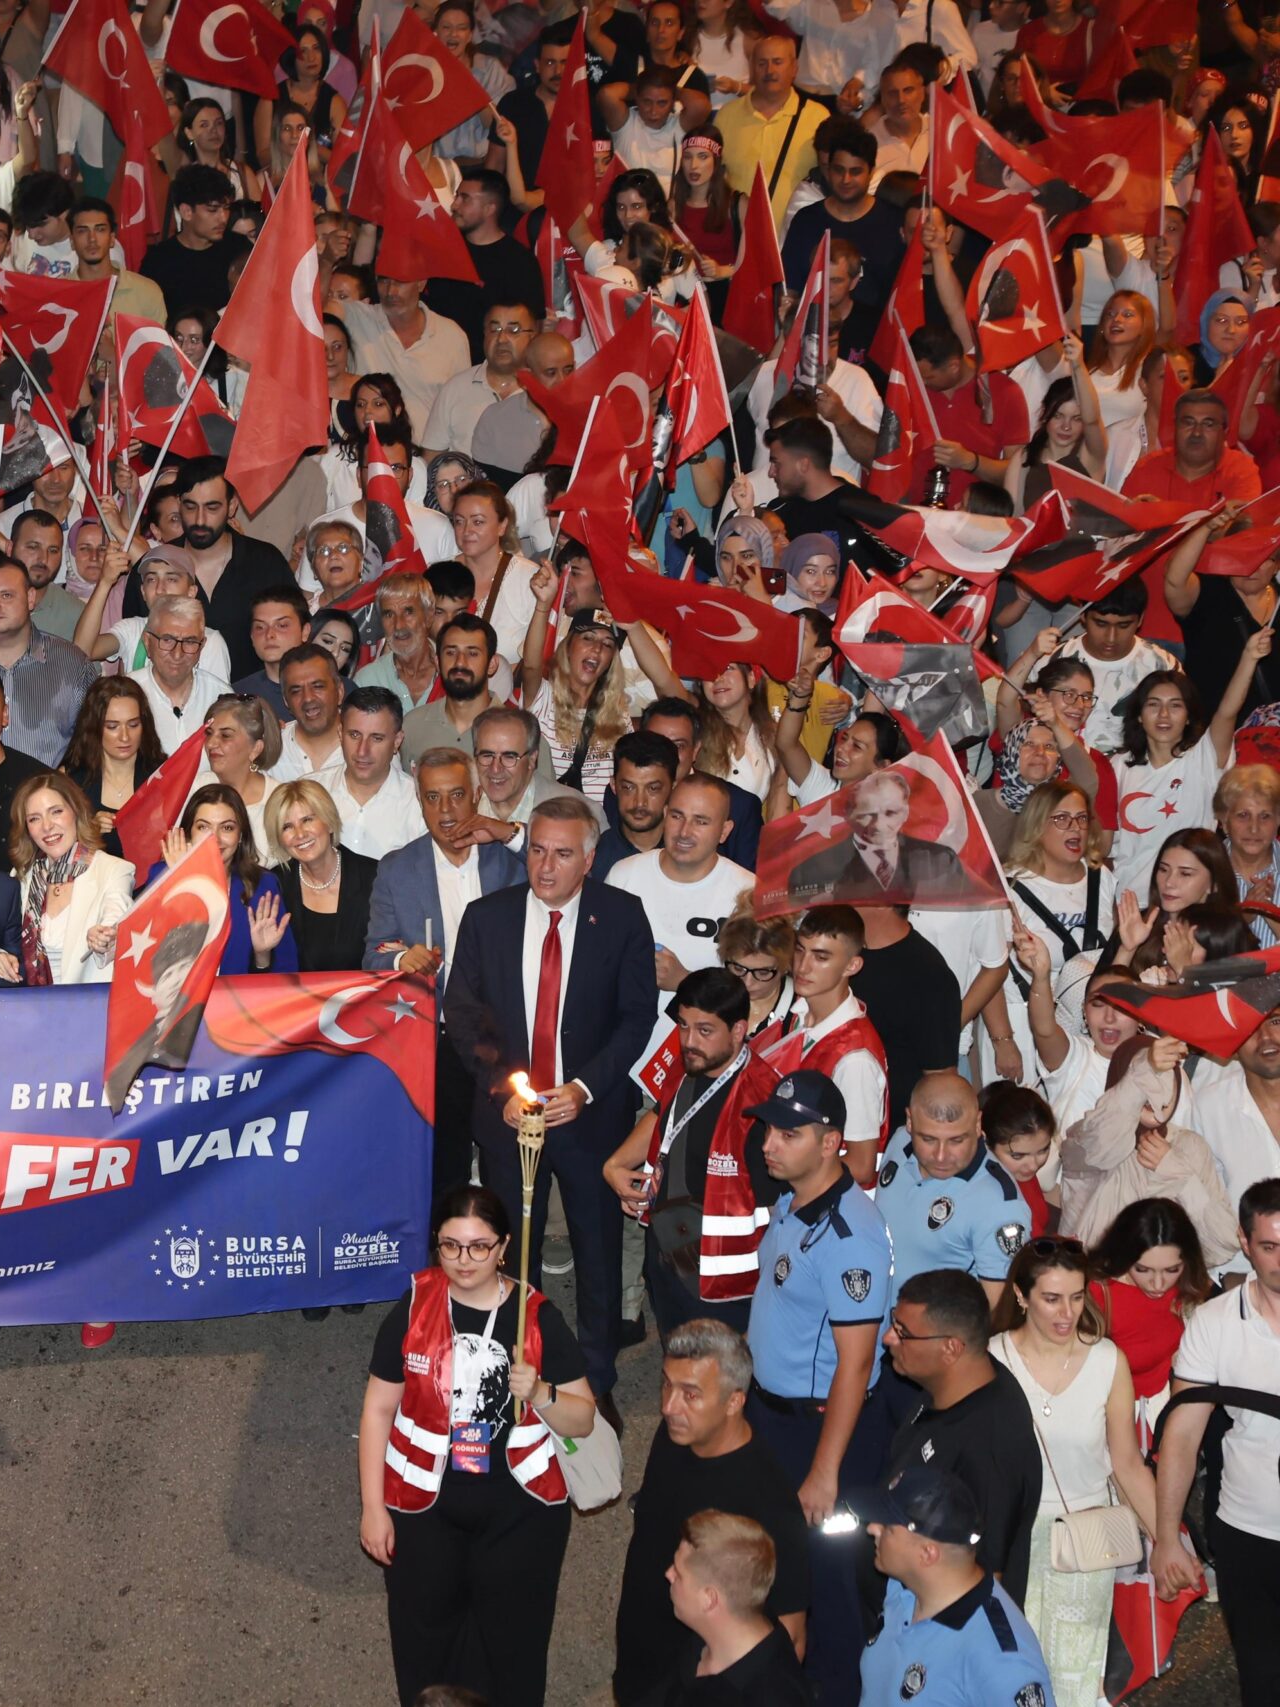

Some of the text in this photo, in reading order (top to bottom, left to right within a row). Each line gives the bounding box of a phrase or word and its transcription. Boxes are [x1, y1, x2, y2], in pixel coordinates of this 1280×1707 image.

[157, 1110, 310, 1176] VAR!
[226, 1235, 305, 1253] BURSA
[341, 1230, 389, 1245] Mustafa
[334, 1241, 400, 1257] BOZBEY
[226, 1250, 306, 1266] BÜYÜKŞEHİR
[334, 1258, 399, 1271] BELEDİYE BAŞKANI
[226, 1262, 307, 1279] BELEDİYESİ
